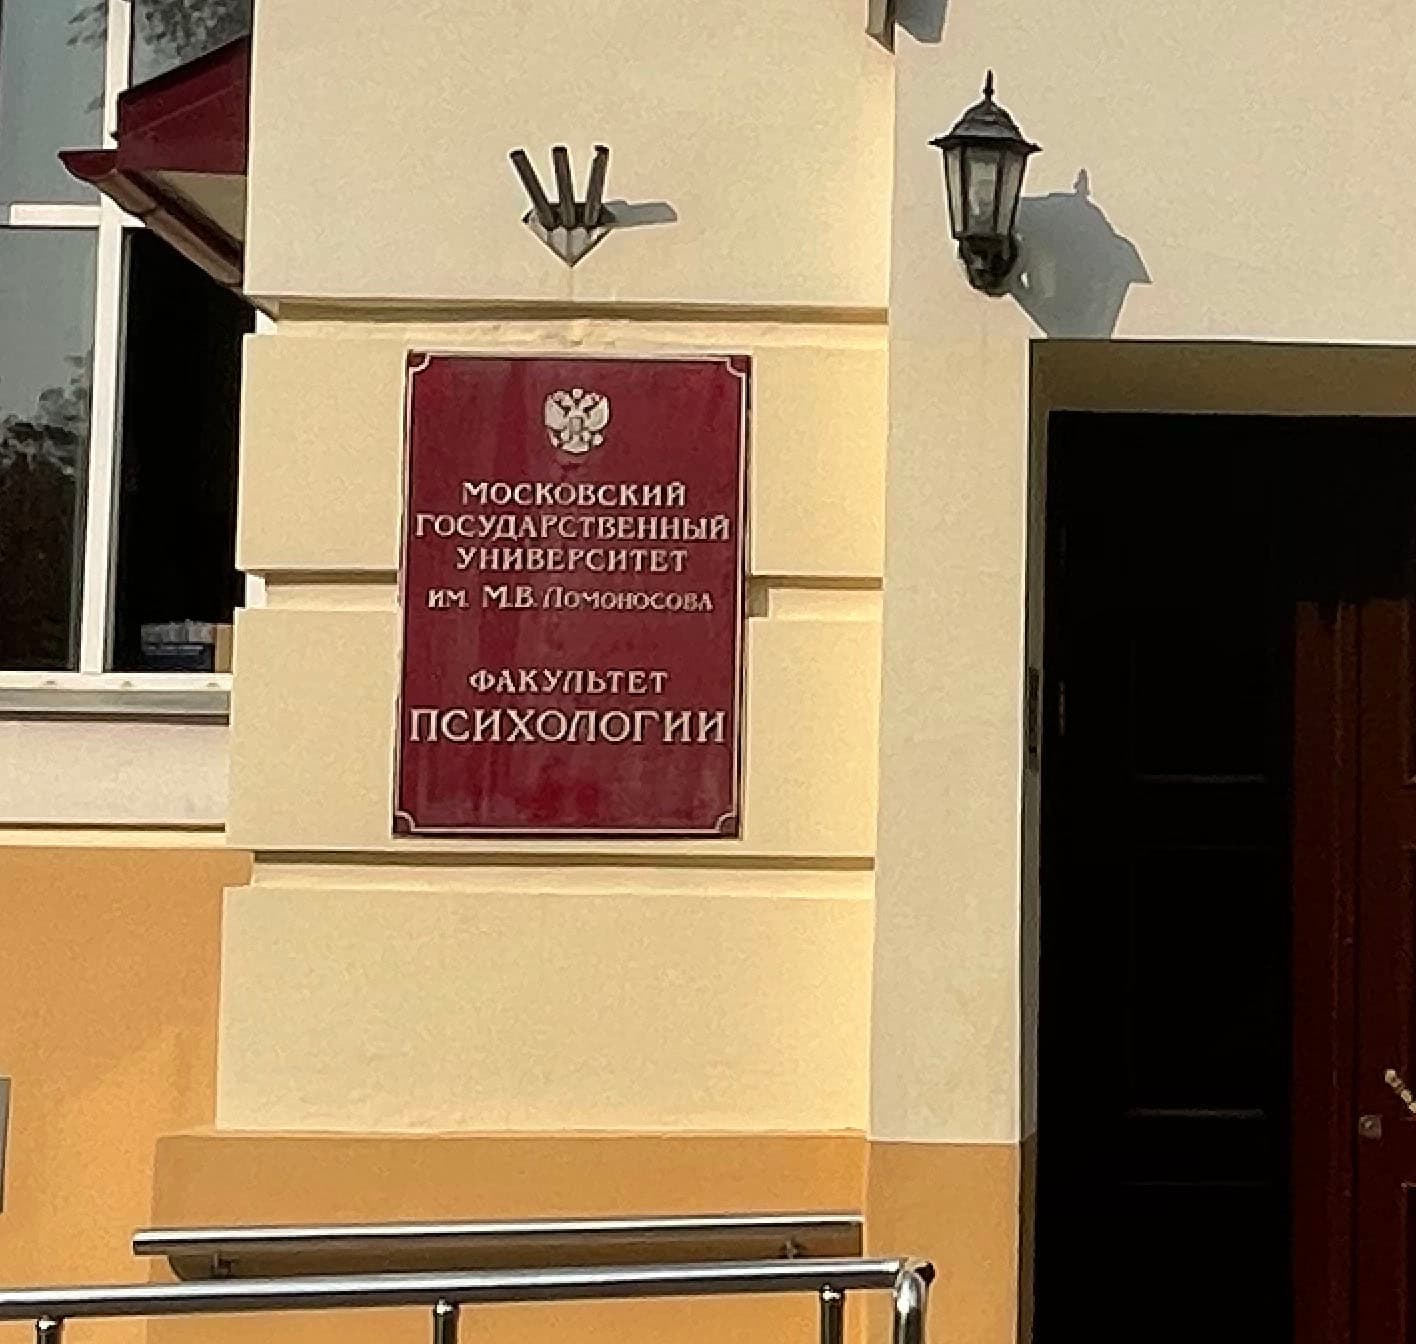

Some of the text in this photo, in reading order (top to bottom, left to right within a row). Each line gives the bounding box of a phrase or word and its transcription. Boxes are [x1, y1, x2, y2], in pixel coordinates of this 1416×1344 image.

[462, 481, 686, 506] МОСКОВСКИЙ
[416, 513, 730, 542] ГОСУДАРСТВЕННЫЙ
[456, 547, 688, 572] УНИВЕРСИТЕТ
[468, 669, 667, 693] ФАКУЛЬТЕТ
[410, 709, 726, 744] ПСИХОЛОГИИ
